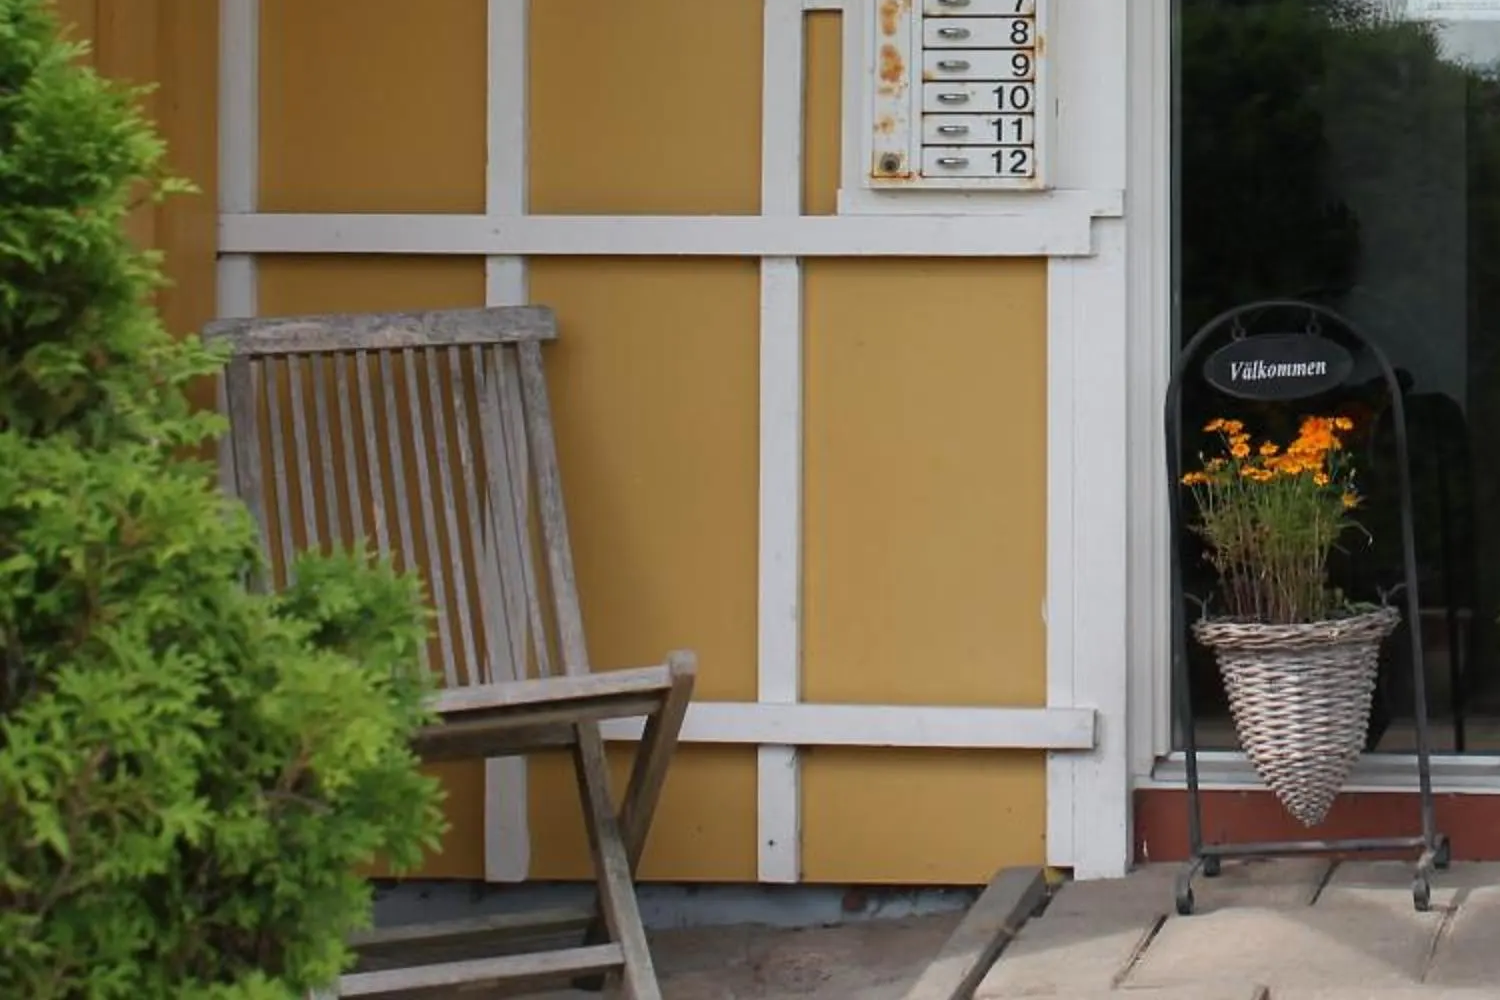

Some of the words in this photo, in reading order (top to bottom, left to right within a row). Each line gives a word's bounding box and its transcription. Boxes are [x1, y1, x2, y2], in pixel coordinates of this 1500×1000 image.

[1010, 20, 1029, 44] 8
[1011, 53, 1030, 77] 9
[992, 85, 1030, 110] 10
[991, 118, 1023, 142] 11
[991, 149, 1027, 174] 12
[1230, 360, 1327, 381] Välkommen
